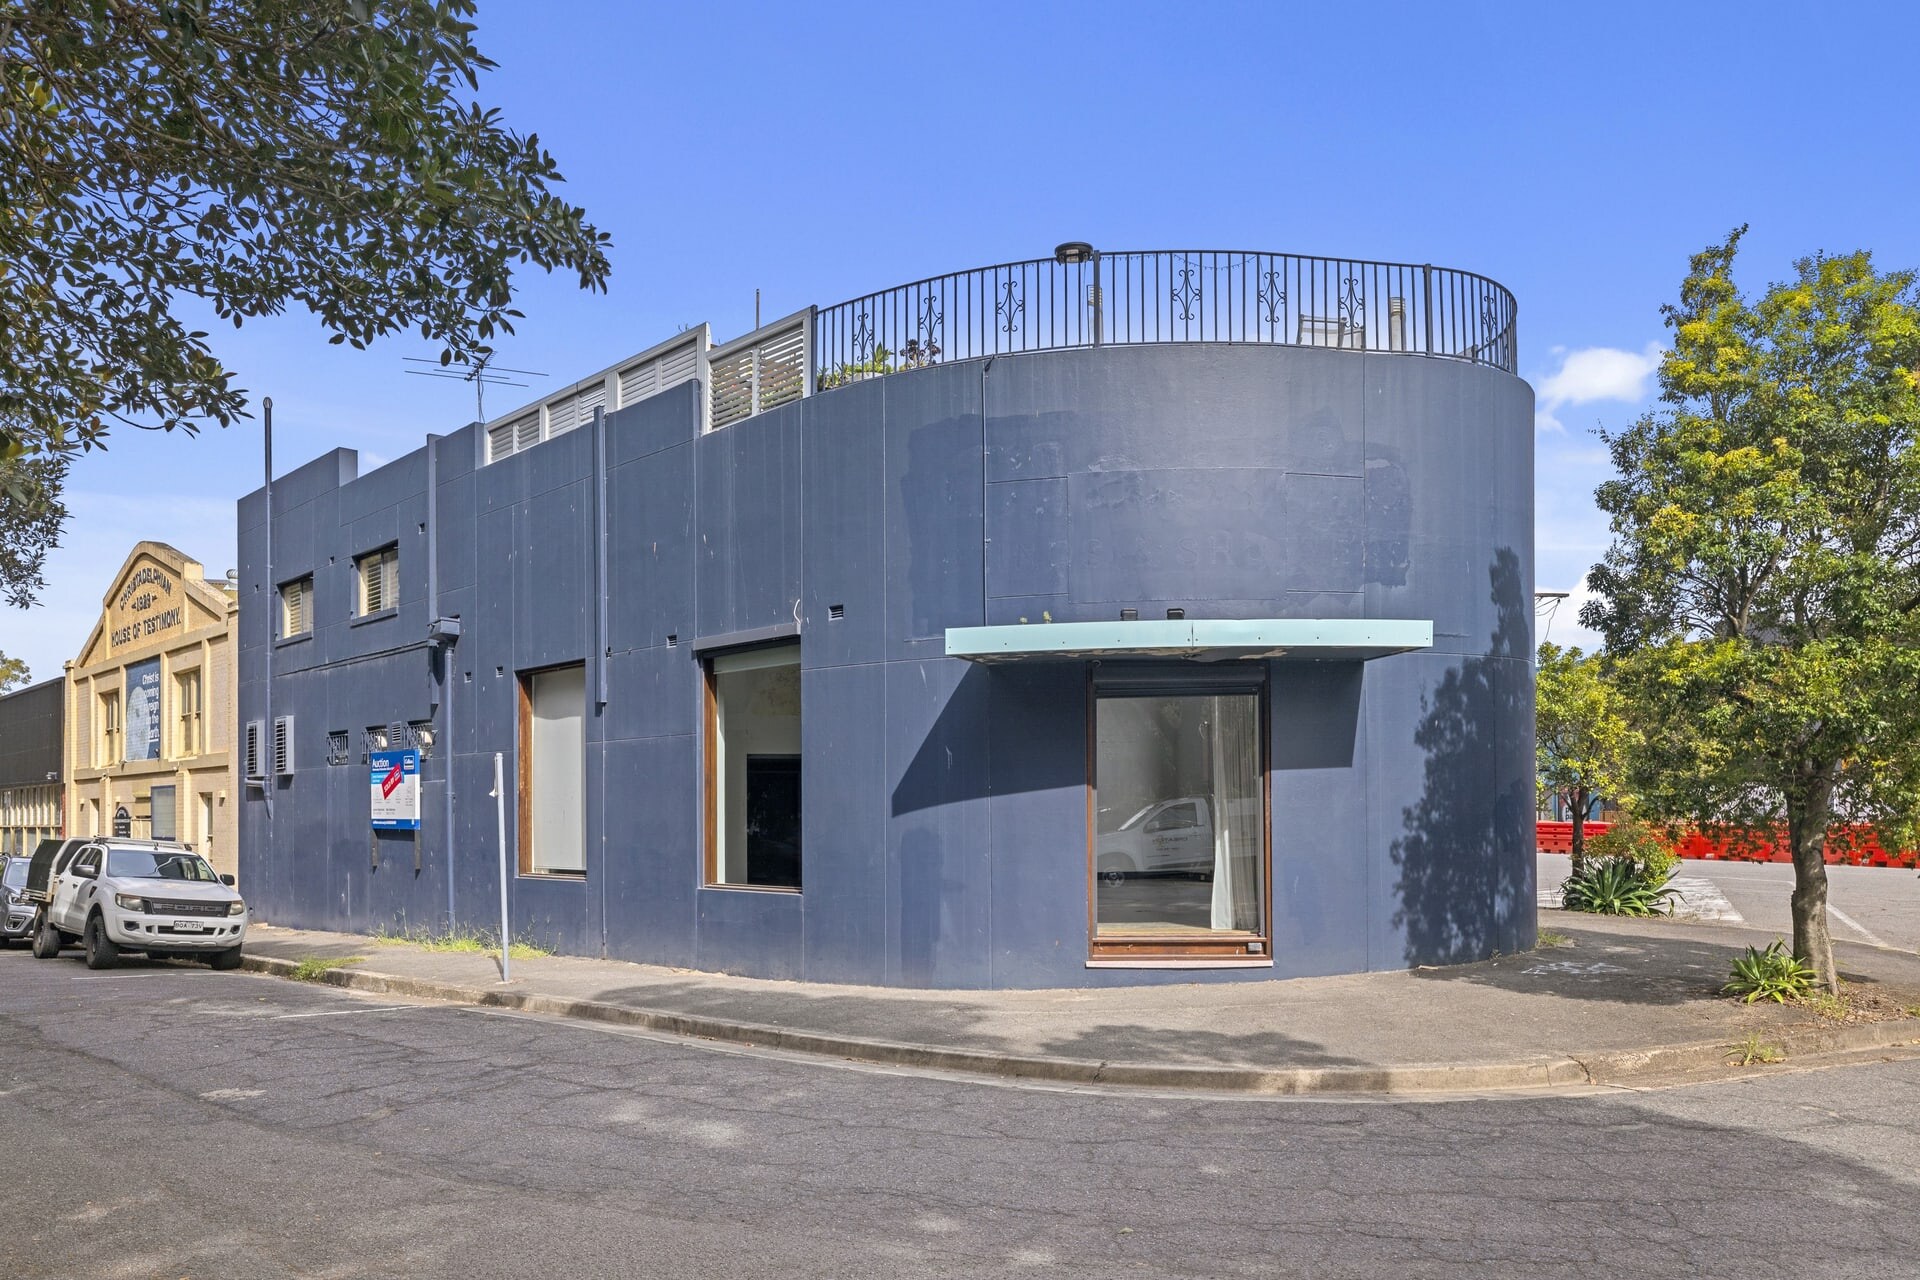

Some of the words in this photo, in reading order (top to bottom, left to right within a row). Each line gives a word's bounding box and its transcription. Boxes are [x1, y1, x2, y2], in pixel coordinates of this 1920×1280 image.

[120, 567, 171, 611] CHRISTADELPHIAN
[112, 626, 131, 648] HOUSE
[133, 622, 141, 639] OF
[142, 672, 155, 685] Christ
[372, 757, 389, 768] Auction
